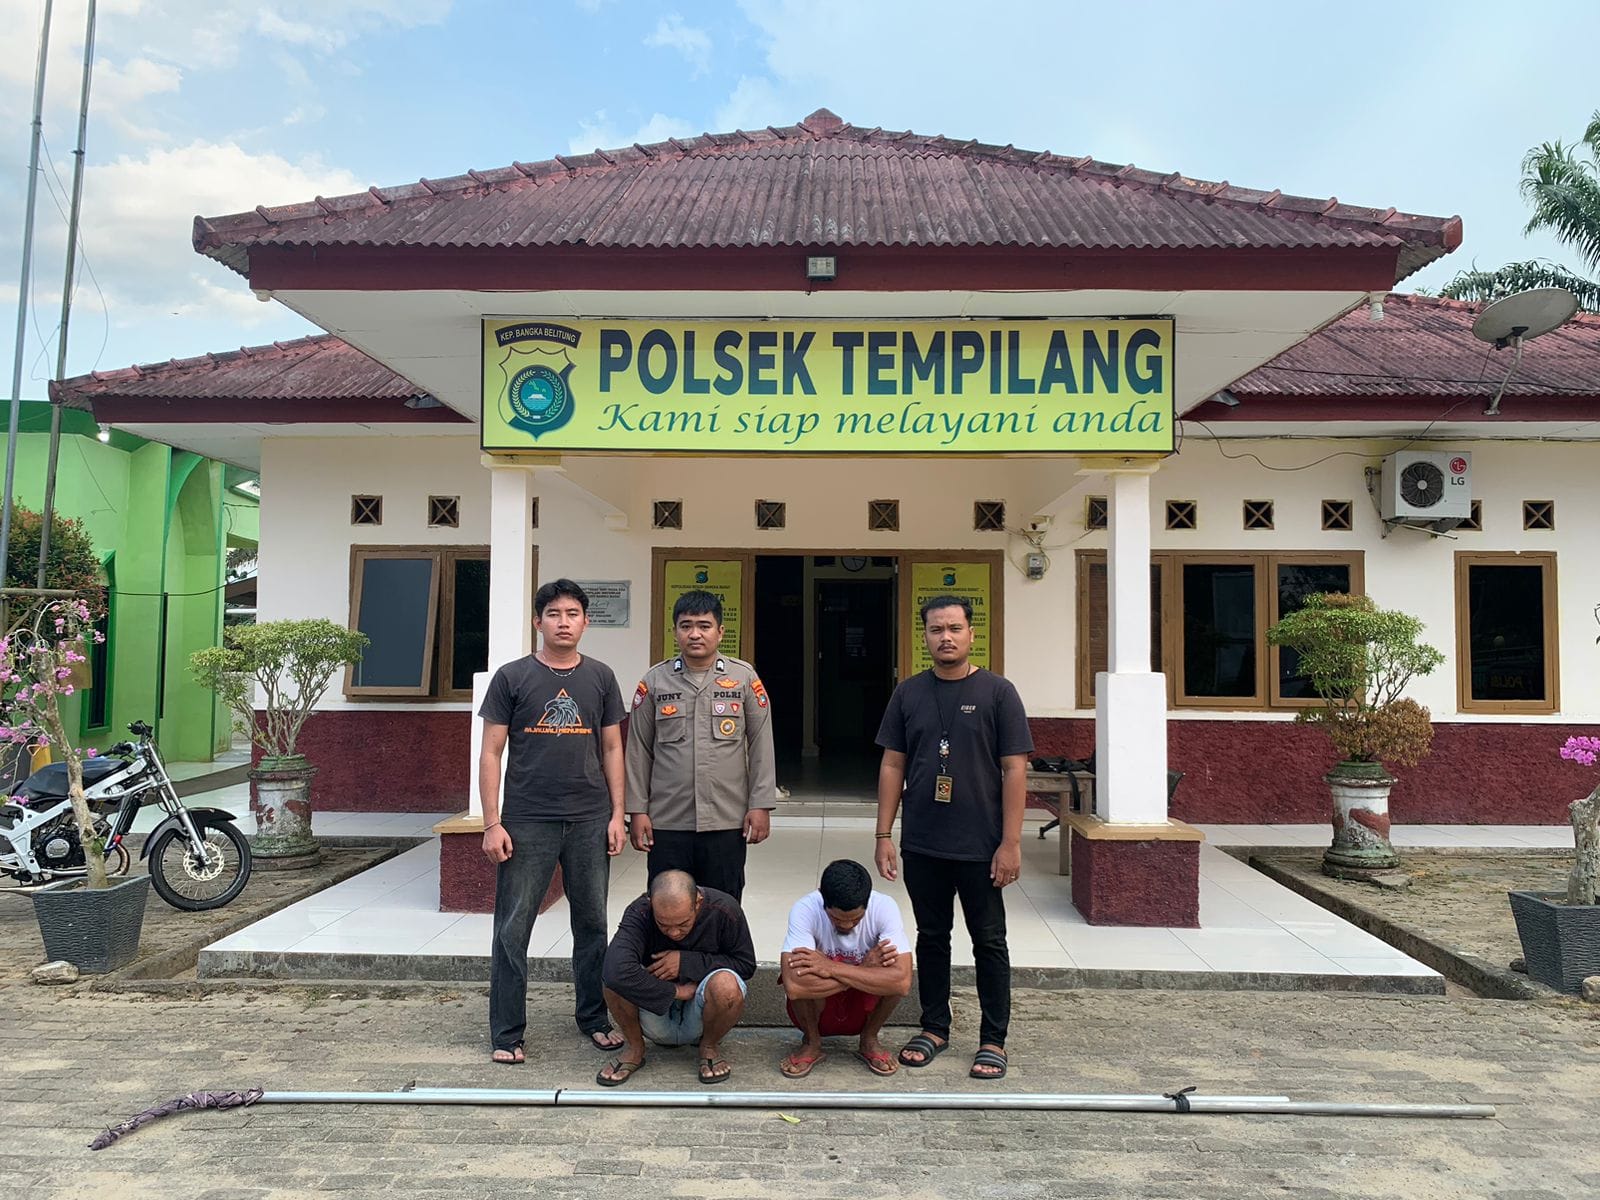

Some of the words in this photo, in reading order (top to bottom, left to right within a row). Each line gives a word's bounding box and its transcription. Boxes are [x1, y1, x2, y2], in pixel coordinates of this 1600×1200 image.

[500, 331, 515, 341] KEP.
[515, 328, 543, 337] BANGKA
[544, 328, 576, 343] BELITUNG
[599, 329, 817, 395] POLSEK
[832, 328, 1163, 395] TEMPILANG
[597, 403, 721, 433] Kami
[733, 404, 819, 445] siap
[833, 401, 1039, 445] melayani
[1052, 400, 1164, 434] anda
[1450, 476, 1465, 486] LG
[656, 692, 682, 702] JUNY
[713, 691, 742, 699] POLRI
